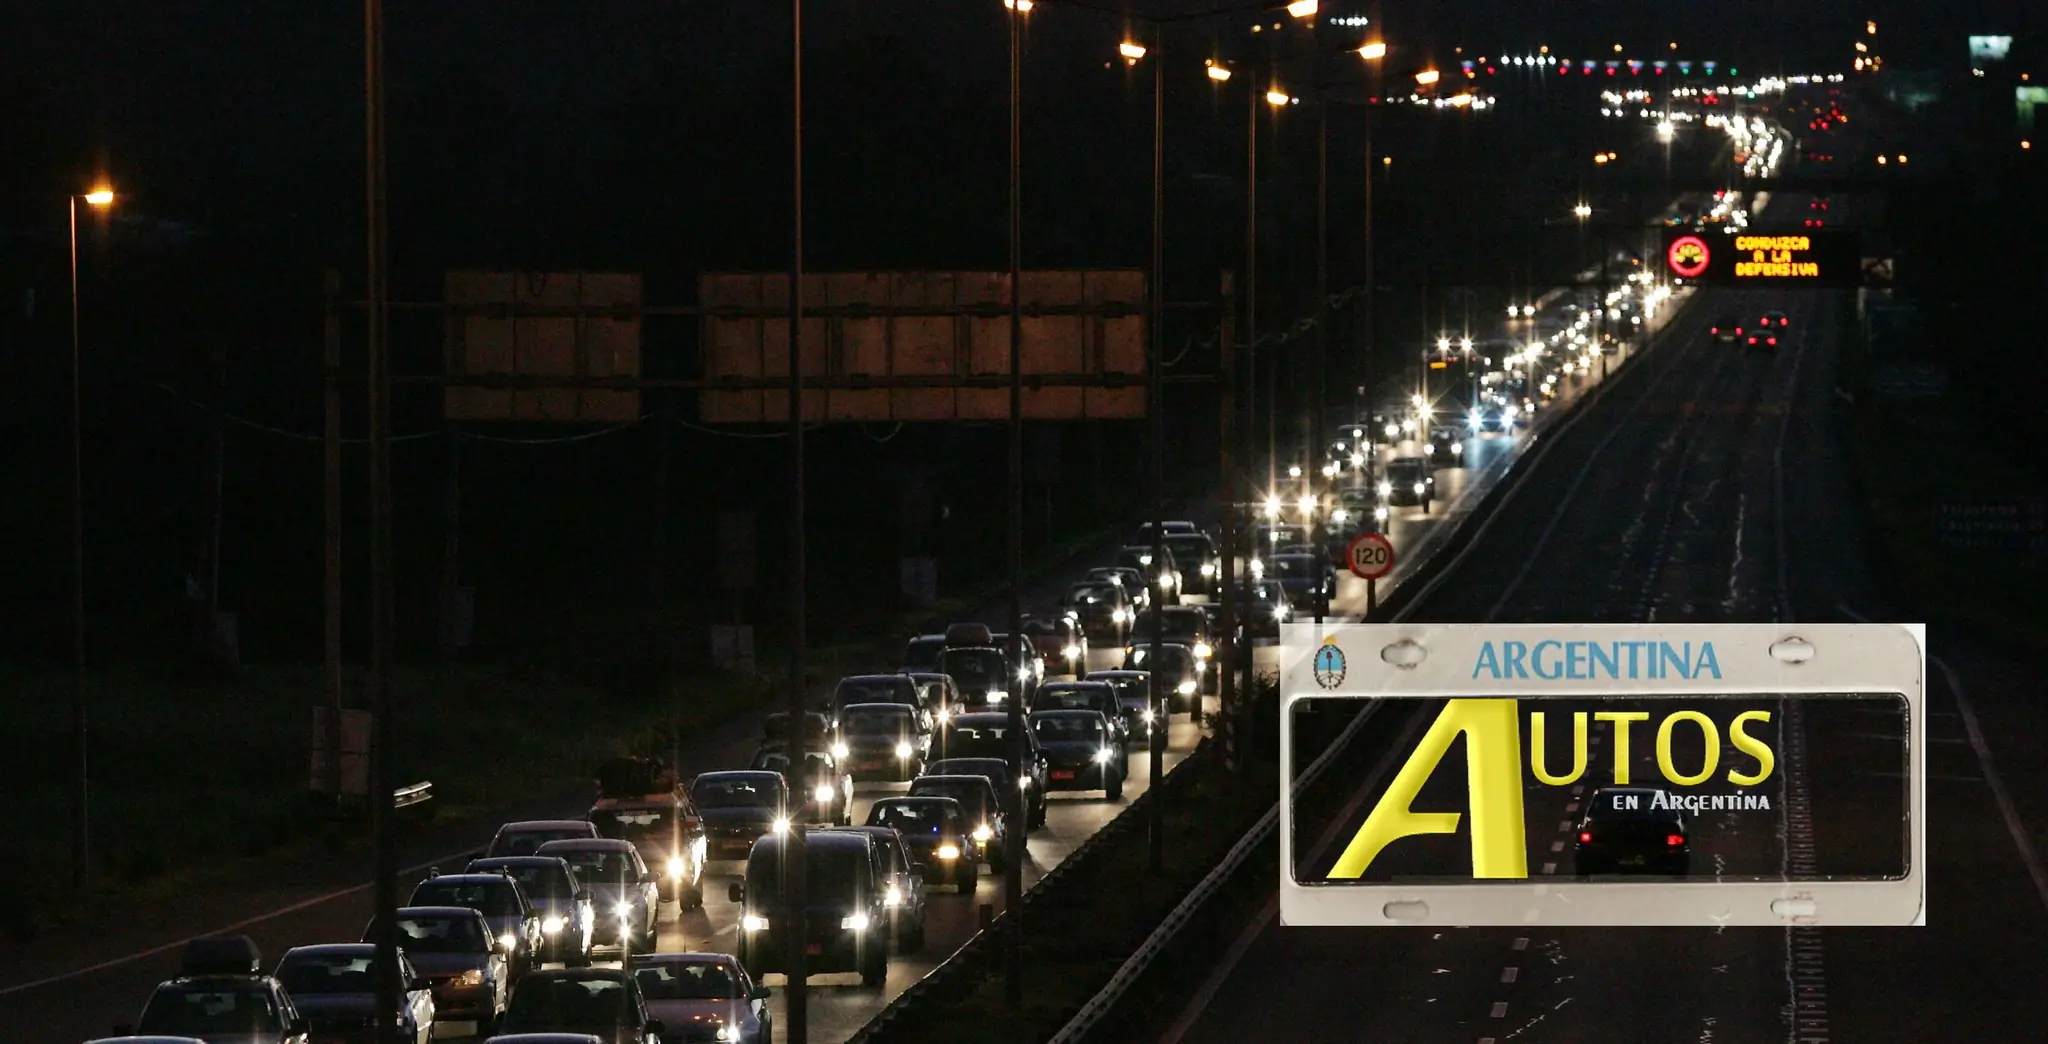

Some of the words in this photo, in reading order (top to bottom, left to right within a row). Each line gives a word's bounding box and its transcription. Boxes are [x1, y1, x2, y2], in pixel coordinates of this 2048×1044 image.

[1736, 236, 1810, 250] CONDUZCA
[1753, 250, 1764, 263] A
[1771, 250, 1792, 263] LA
[1736, 262, 1818, 276] DEFENSIVA
[1355, 547, 1387, 565] 120
